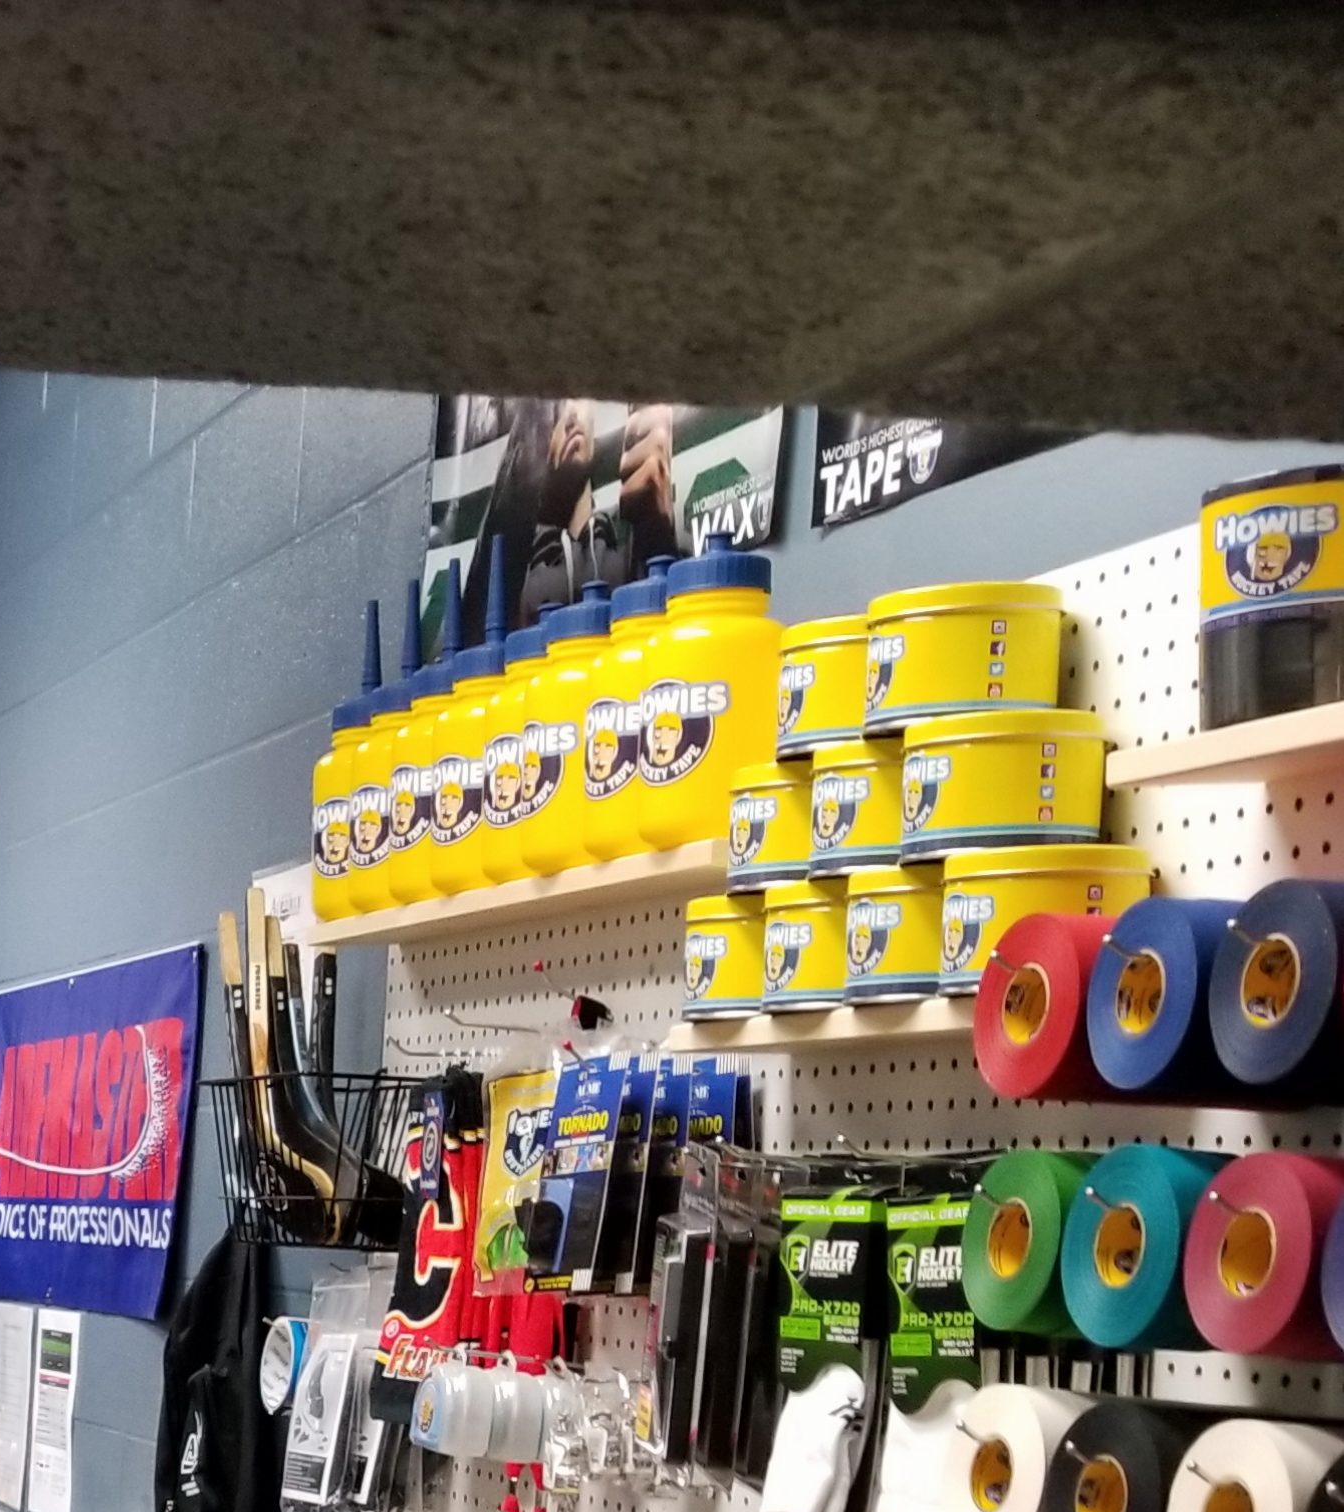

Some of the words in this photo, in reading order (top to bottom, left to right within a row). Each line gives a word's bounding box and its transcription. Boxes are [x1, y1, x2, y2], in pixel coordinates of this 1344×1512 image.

[822, 440, 866, 464] WORLD'S
[868, 425, 905, 446] HIGHEST
[820, 440, 905, 515] TAPE
[691, 493, 755, 558] WAX
[1216, 504, 1338, 551] HOWIES
[1231, 571, 1275, 596] HOCKEY
[1278, 561, 1310, 589] TAPE
[641, 684, 729, 721] OWIES
[585, 706, 640, 737] OWIE
[670, 744, 702, 775] TAPE
[607, 760, 635, 789] TAPE
[815, 778, 868, 803] OWIES
[732, 799, 776, 824] OWIES
[558, 1112, 609, 1135] TORNADO
[28, 1204, 47, 1240] OF
[786, 1205, 831, 1215] OFFICIAL
[834, 1206, 865, 1215] GEAR
[890, 1212, 936, 1223] OFFICIAL
[813, 1241, 860, 1259] ELITE
[919, 1246, 962, 1265] ELIT
[809, 1258, 854, 1273] HOCKEY
[917, 1265, 963, 1281] HOCKEY
